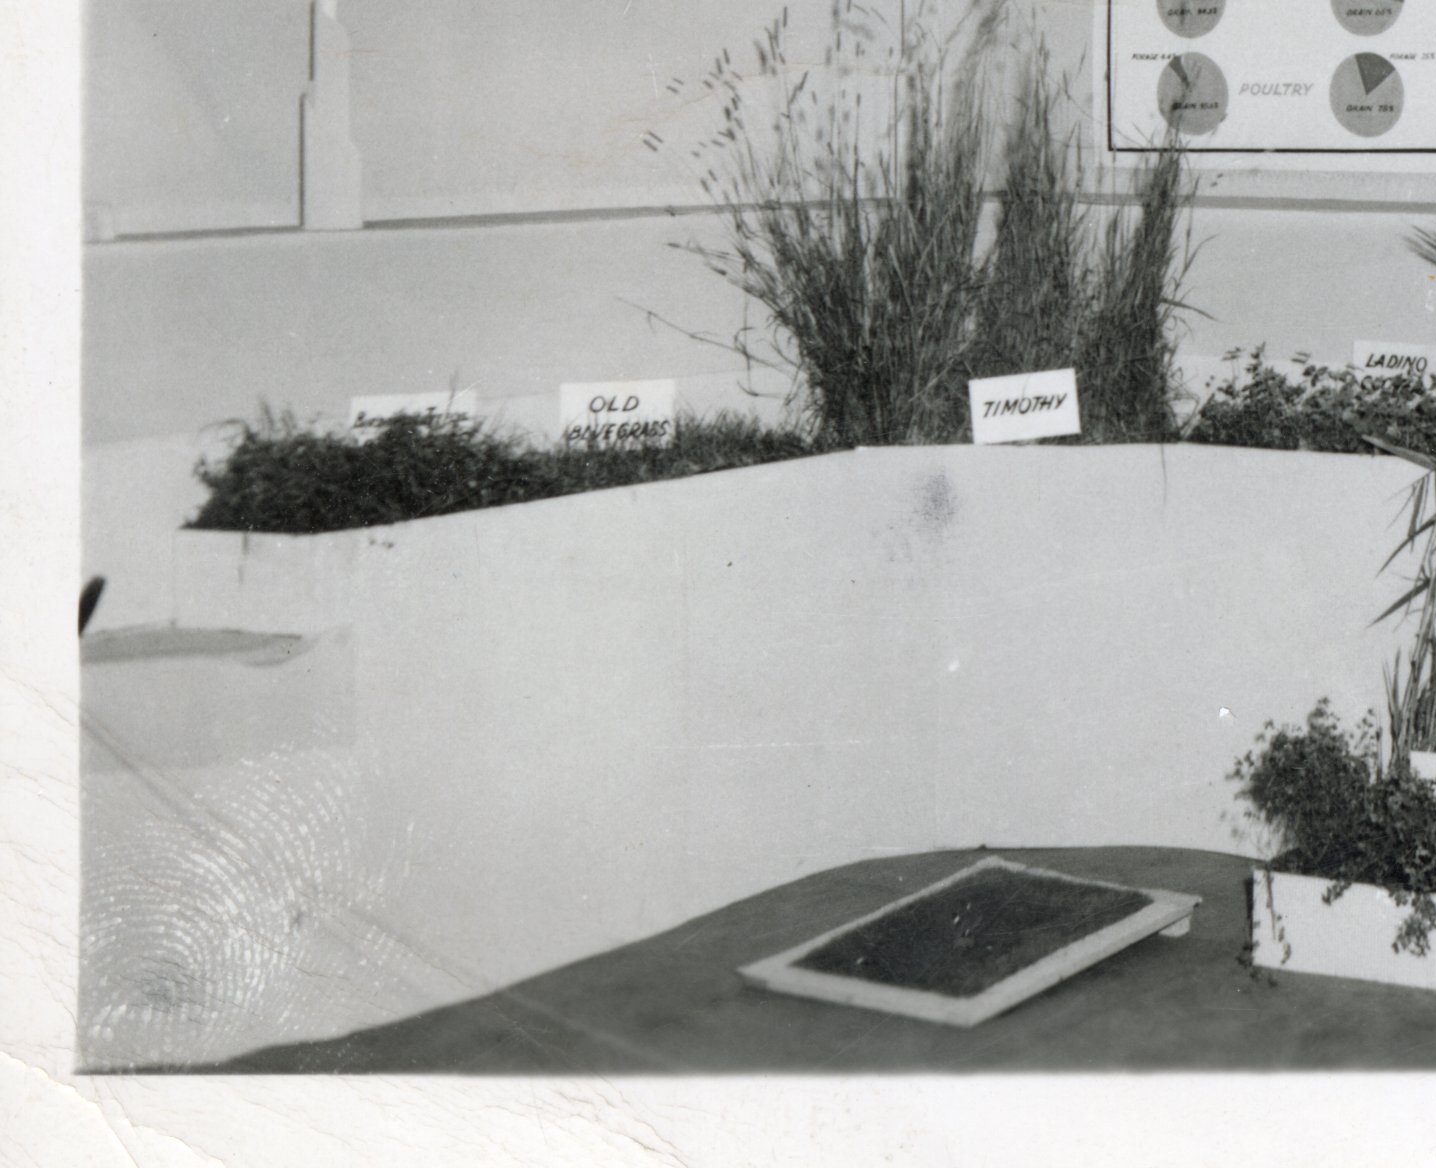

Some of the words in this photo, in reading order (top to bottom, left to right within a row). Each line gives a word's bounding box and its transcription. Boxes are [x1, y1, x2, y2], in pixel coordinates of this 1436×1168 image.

[1239, 83, 1314, 97] POULTRY
[1365, 352, 1428, 373] LADINO
[589, 395, 640, 413] OLD
[982, 393, 1068, 419] TIMOTHY
[568, 420, 670, 442] BLUEGRASS
